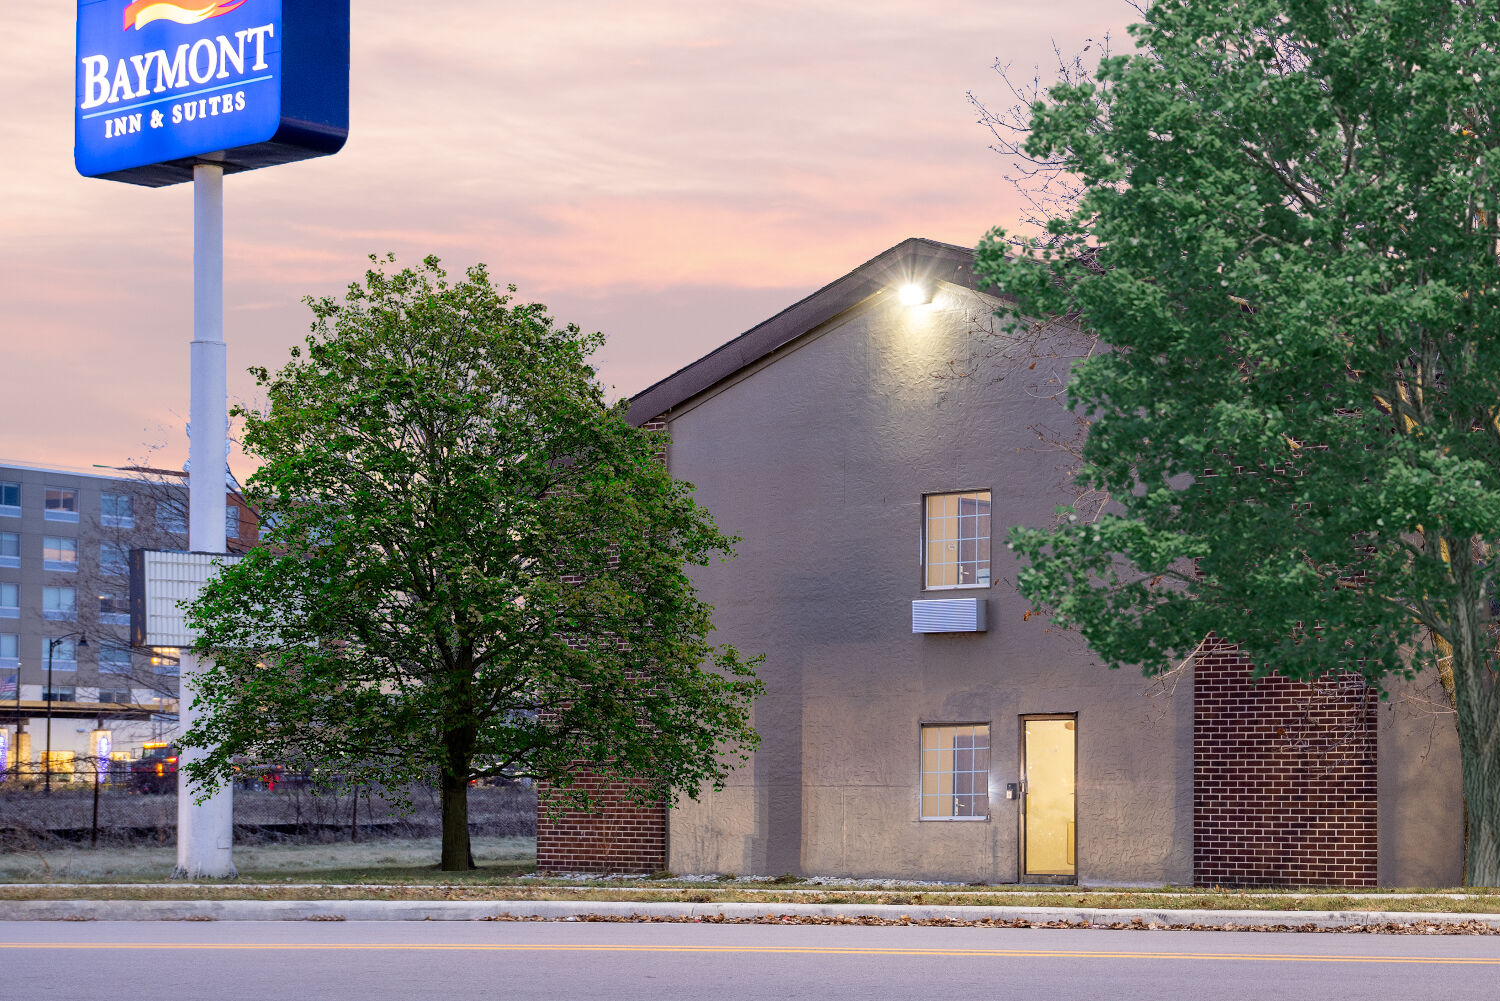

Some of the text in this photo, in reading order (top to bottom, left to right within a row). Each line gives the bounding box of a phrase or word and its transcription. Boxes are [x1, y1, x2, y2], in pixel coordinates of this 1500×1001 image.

[81, 23, 274, 109] BAYMONT
[104, 91, 246, 138] INN & SUITES
